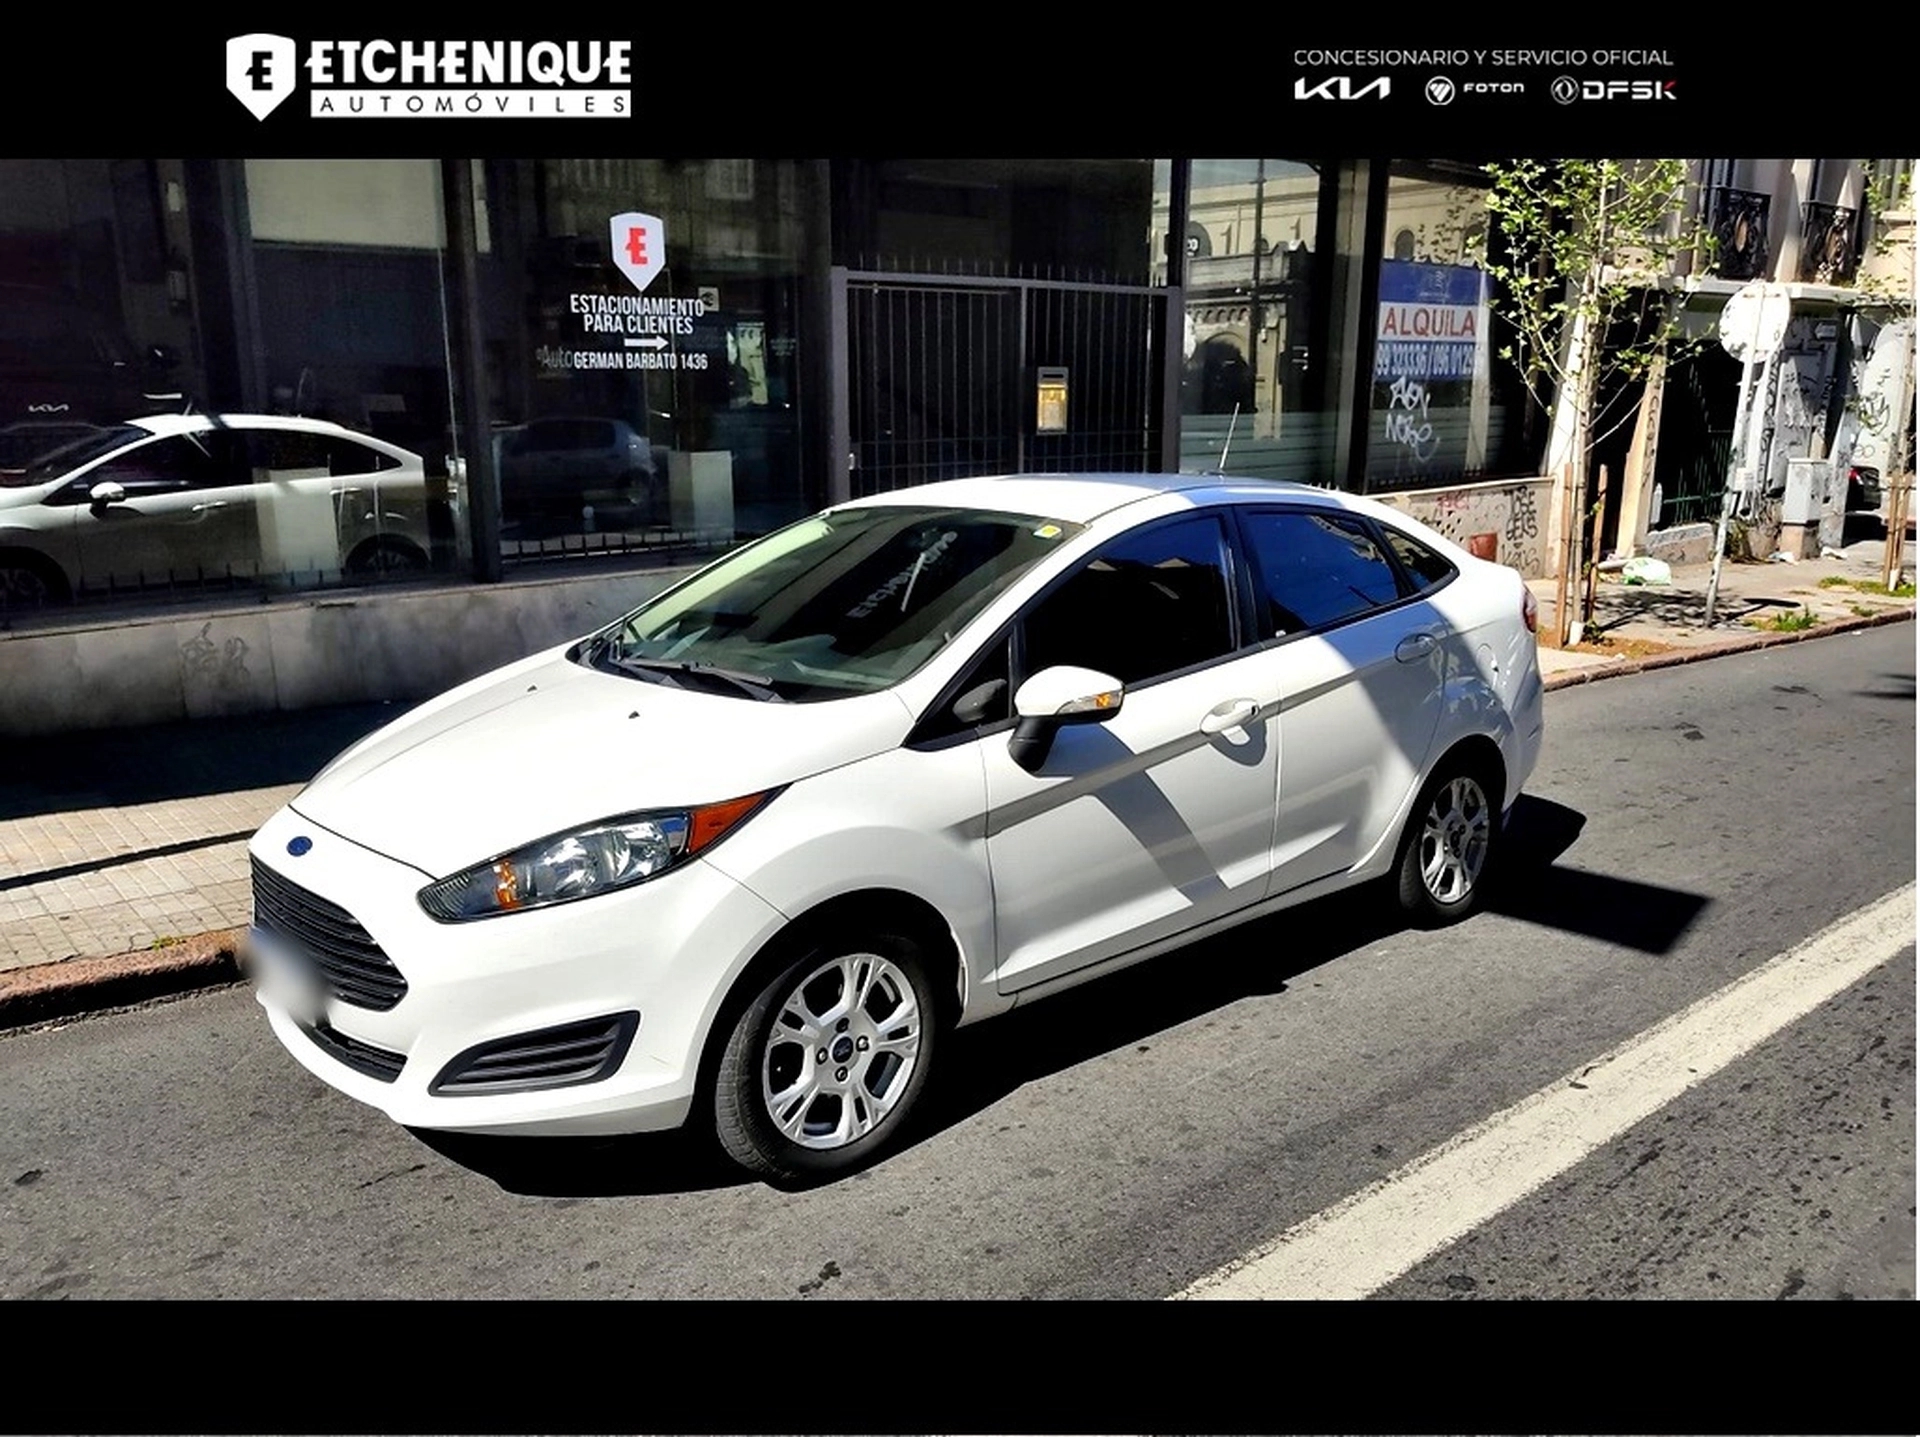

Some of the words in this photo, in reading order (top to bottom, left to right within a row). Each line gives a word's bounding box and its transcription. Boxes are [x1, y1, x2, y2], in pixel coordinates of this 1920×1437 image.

[570, 294, 705, 317] ESTACIONAMIENTO
[584, 313, 624, 333] PARA
[626, 315, 694, 334] CLIENTES
[1382, 306, 1476, 337] ALQUILA
[573, 351, 623, 369] GERMAN
[625, 352, 678, 369] BARBATO
[681, 353, 708, 369] 1436
